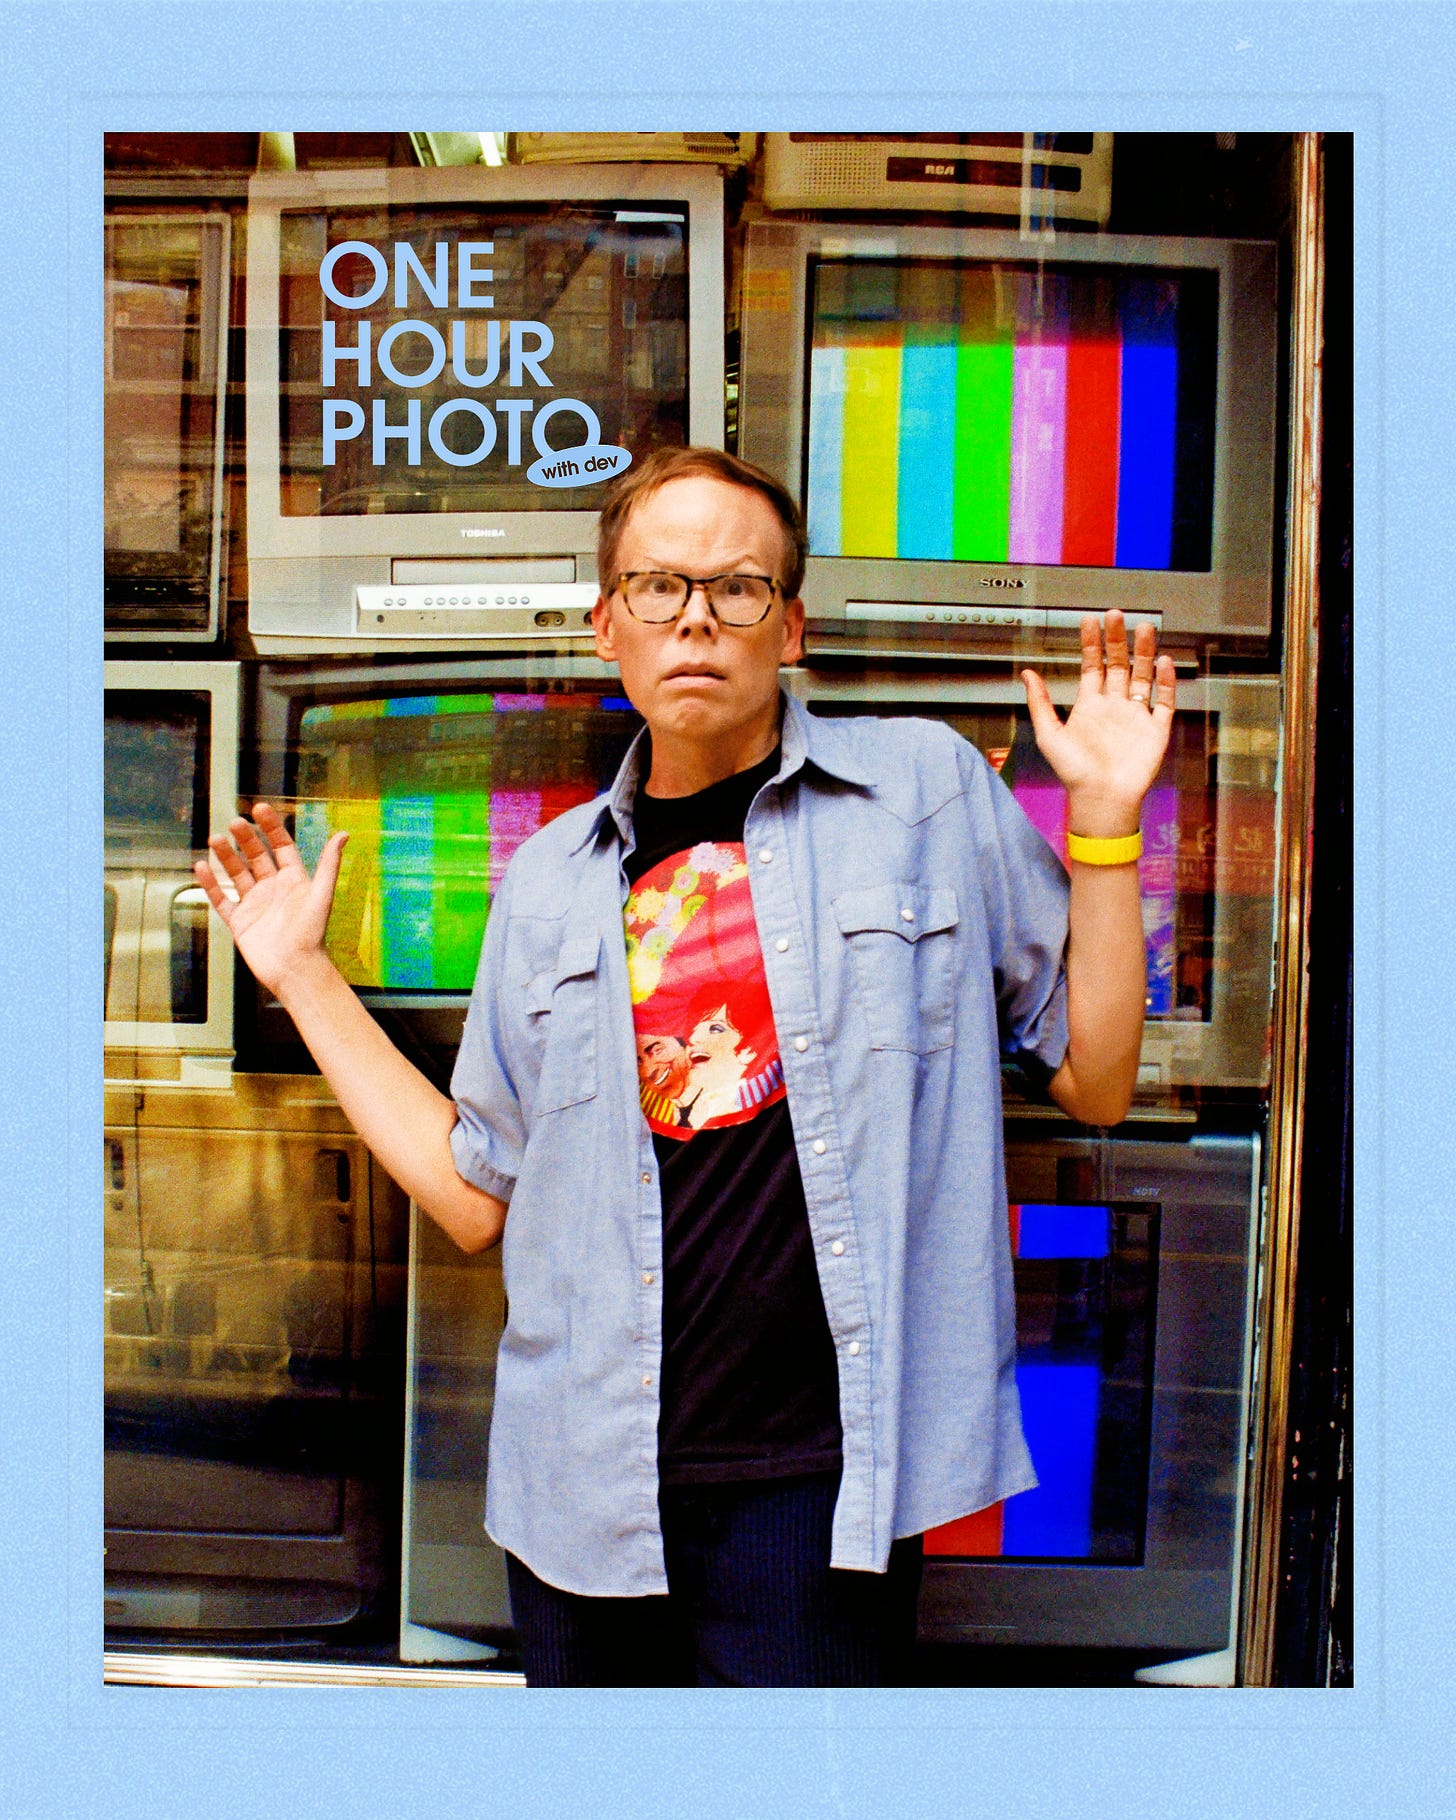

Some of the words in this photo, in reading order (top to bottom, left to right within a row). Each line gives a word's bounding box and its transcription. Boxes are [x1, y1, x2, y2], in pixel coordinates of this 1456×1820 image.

[925, 165, 955, 175] RCA
[461, 528, 506, 538] TOSHIBA
[979, 577, 1030, 589] SONY
